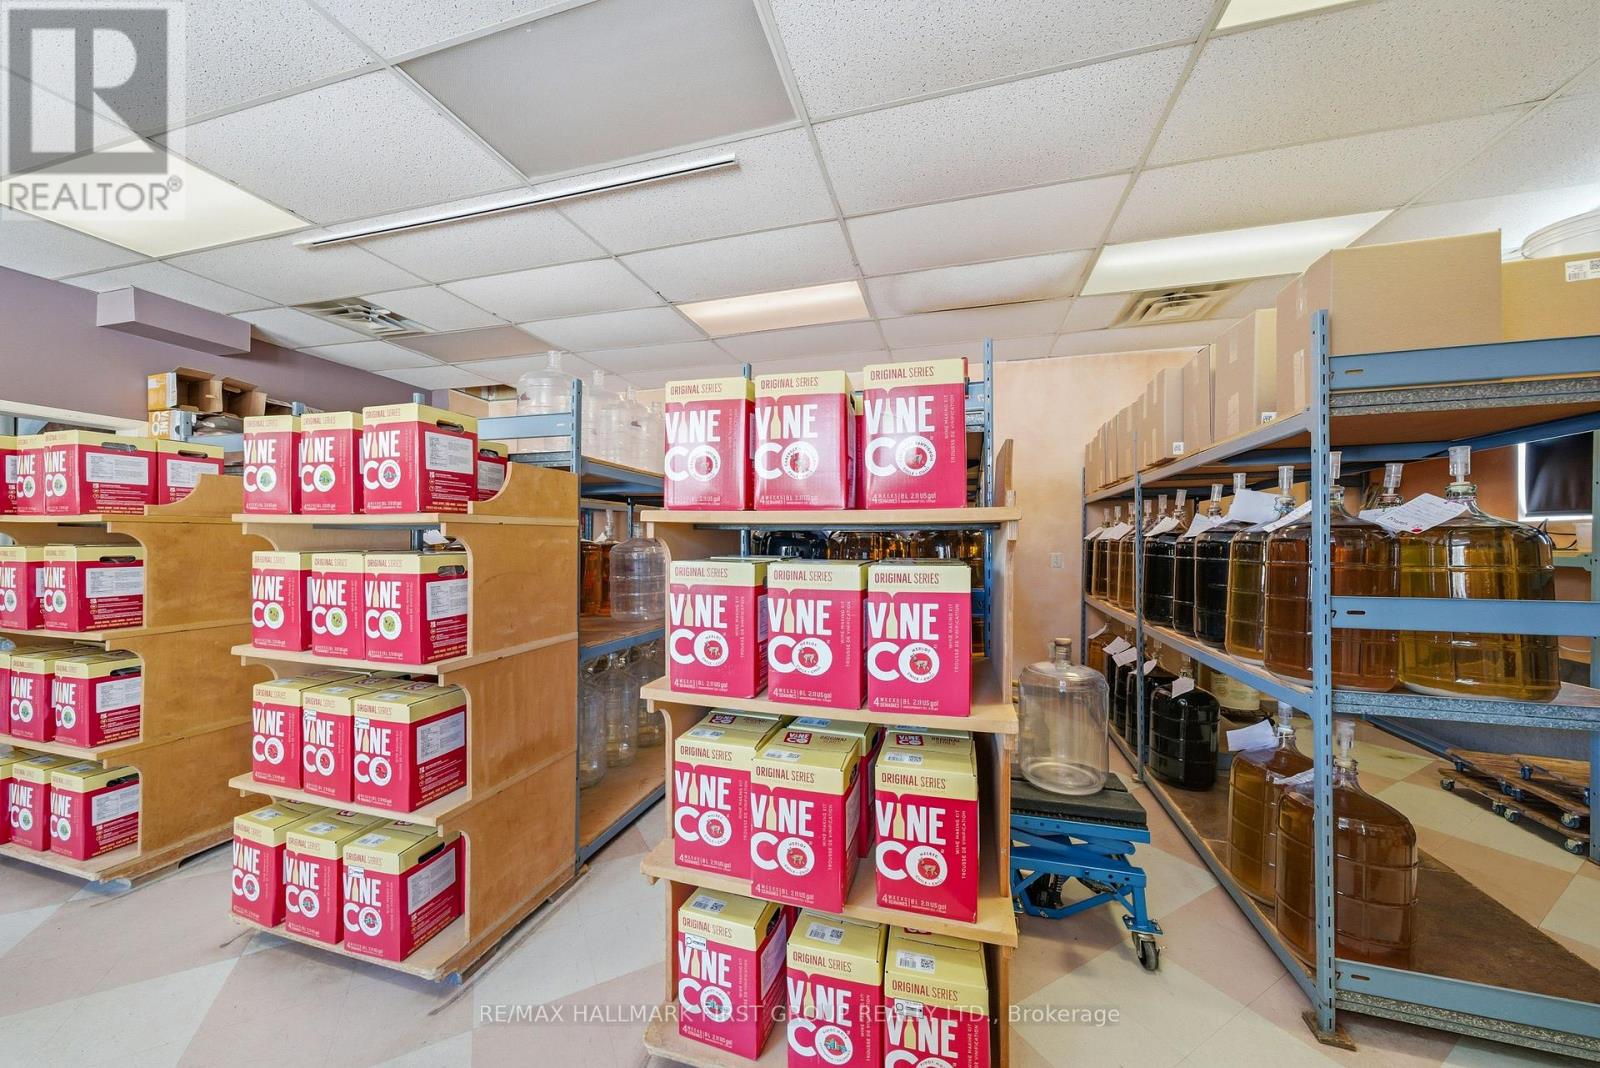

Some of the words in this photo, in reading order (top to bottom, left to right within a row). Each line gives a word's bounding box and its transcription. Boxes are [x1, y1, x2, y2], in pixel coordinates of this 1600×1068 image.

[671, 385, 700, 396] ORIGINAL
[701, 383, 722, 394] SERIES
[760, 379, 794, 390] ORIGINAL
[796, 376, 819, 388] SERIES
[870, 368, 907, 381] ORIGINAL
[909, 366, 934, 378] SERIES
[665, 410, 721, 444] VINE
[755, 404, 818, 440] VINE
[864, 396, 935, 434] VINE
[244, 438, 277, 464] VINE
[302, 436, 335, 463] VINE
[363, 430, 400, 459] VINE
[754, 441, 820, 480] CO
[864, 436, 936, 477] CO
[664, 444, 721, 481] CO
[252, 576, 284, 601] VINE
[674, 566, 705, 578] ORIGINAL
[706, 568, 728, 578] SERIES
[774, 570, 808, 580] ORIGINAL
[809, 570, 832, 582] SERIES
[874, 572, 912, 584] ORIGINAL
[914, 573, 940, 585] SERIES
[312, 579, 348, 606] VINE
[365, 580, 402, 609] VINE
[670, 593, 728, 628] VINE
[768, 598, 832, 636] VINE
[868, 602, 940, 640] VINE
[670, 628, 730, 667] CO
[768, 635, 833, 676] CO
[868, 642, 940, 684] CO
[252, 708, 284, 737] VINE
[303, 718, 334, 748] VINE
[354, 727, 392, 756] VINE
[680, 746, 710, 758] ORIGINAL
[712, 749, 732, 761] SERIES
[674, 770, 732, 811] VINE
[756, 766, 790, 781] ORIGINAL
[790, 770, 815, 784] SERIES
[881, 772, 919, 787] ORIGINAL
[920, 776, 946, 790] SERIES
[674, 806, 732, 847] CO
[750, 792, 814, 838] VINE
[875, 800, 946, 846] VINE
[750, 832, 815, 877] CO
[876, 840, 948, 888] CO
[286, 856, 320, 890] VINE
[343, 876, 382, 908] VINE
[682, 916, 711, 934] ORIGINAL
[712, 923, 732, 939] SERIES
[678, 940, 732, 989] VINE
[792, 951, 827, 968] ORIGINAL
[828, 958, 852, 973] SERIES
[678, 978, 733, 1023] CO
[786, 976, 852, 1027] VINE
[892, 980, 930, 997] ORIGINAL
[932, 988, 958, 1002] SERIES
[787, 1018, 853, 1066] CO
[885, 1007, 958, 1059] VINE
